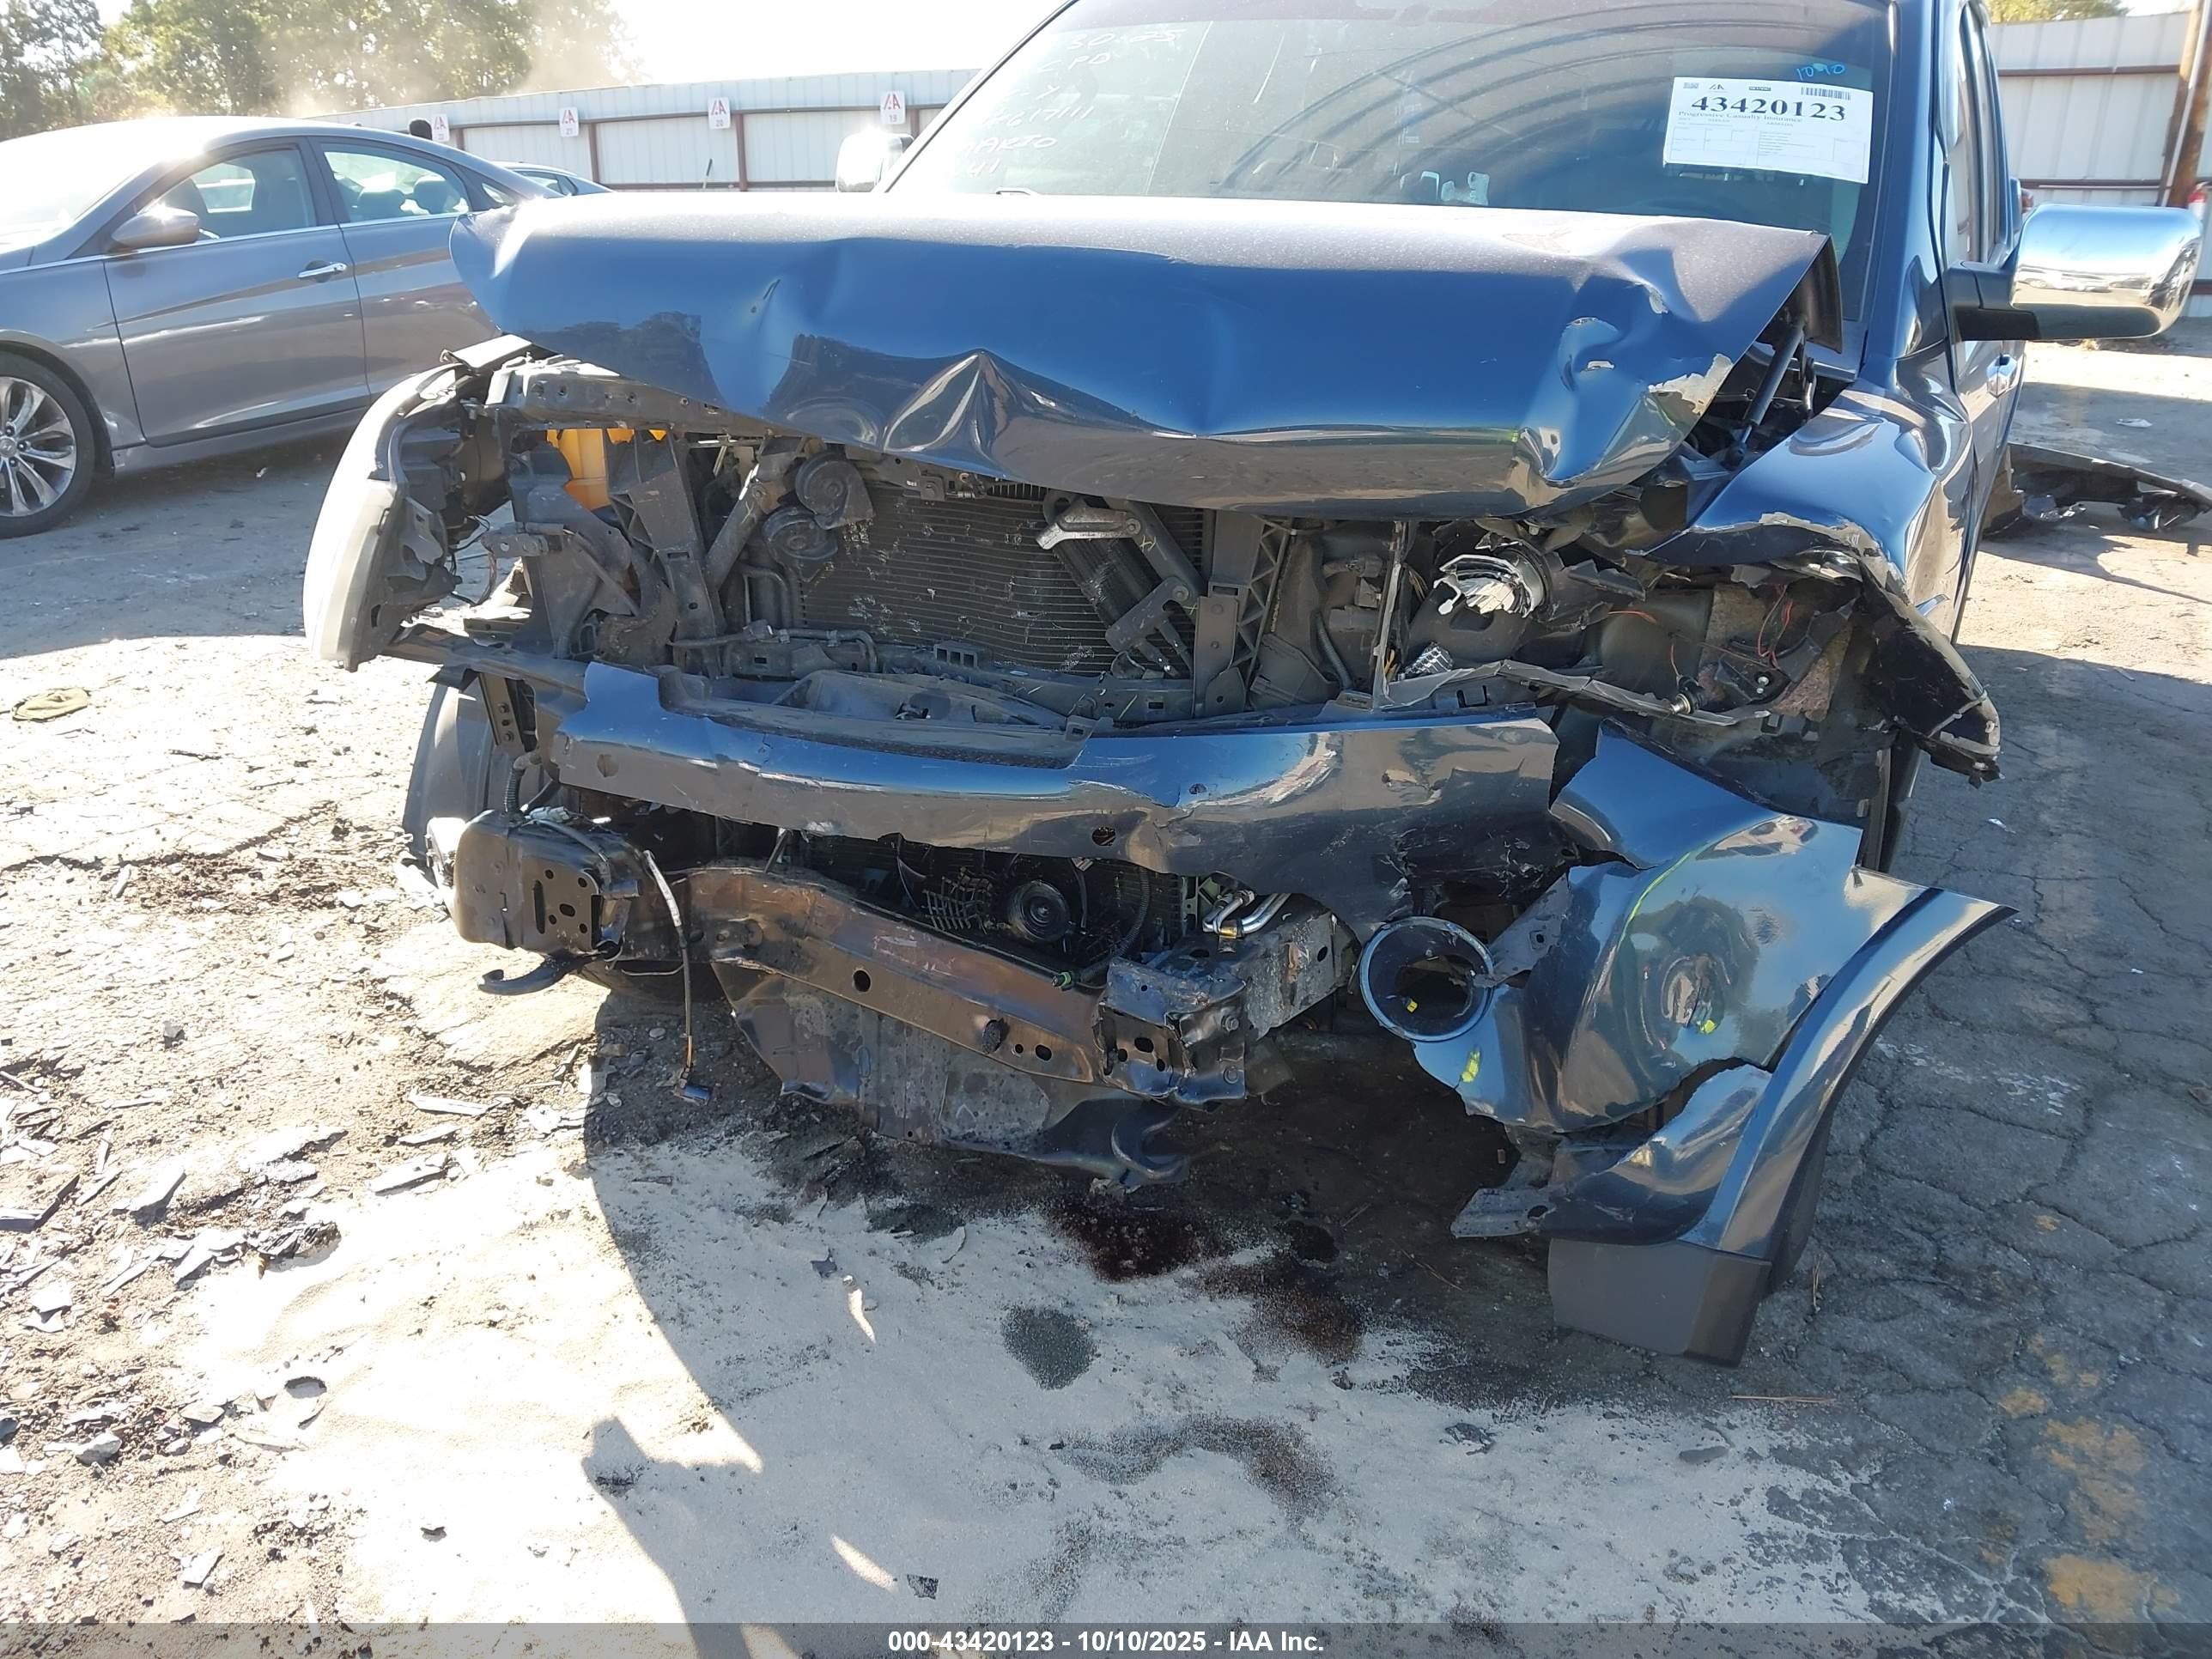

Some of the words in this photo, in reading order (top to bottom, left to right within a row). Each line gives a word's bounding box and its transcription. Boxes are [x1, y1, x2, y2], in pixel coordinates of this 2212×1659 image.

[1678, 111, 1725, 119] Progressive
[1726, 113, 1761, 122] Casualty
[1691, 95, 1845, 121] 43420123
